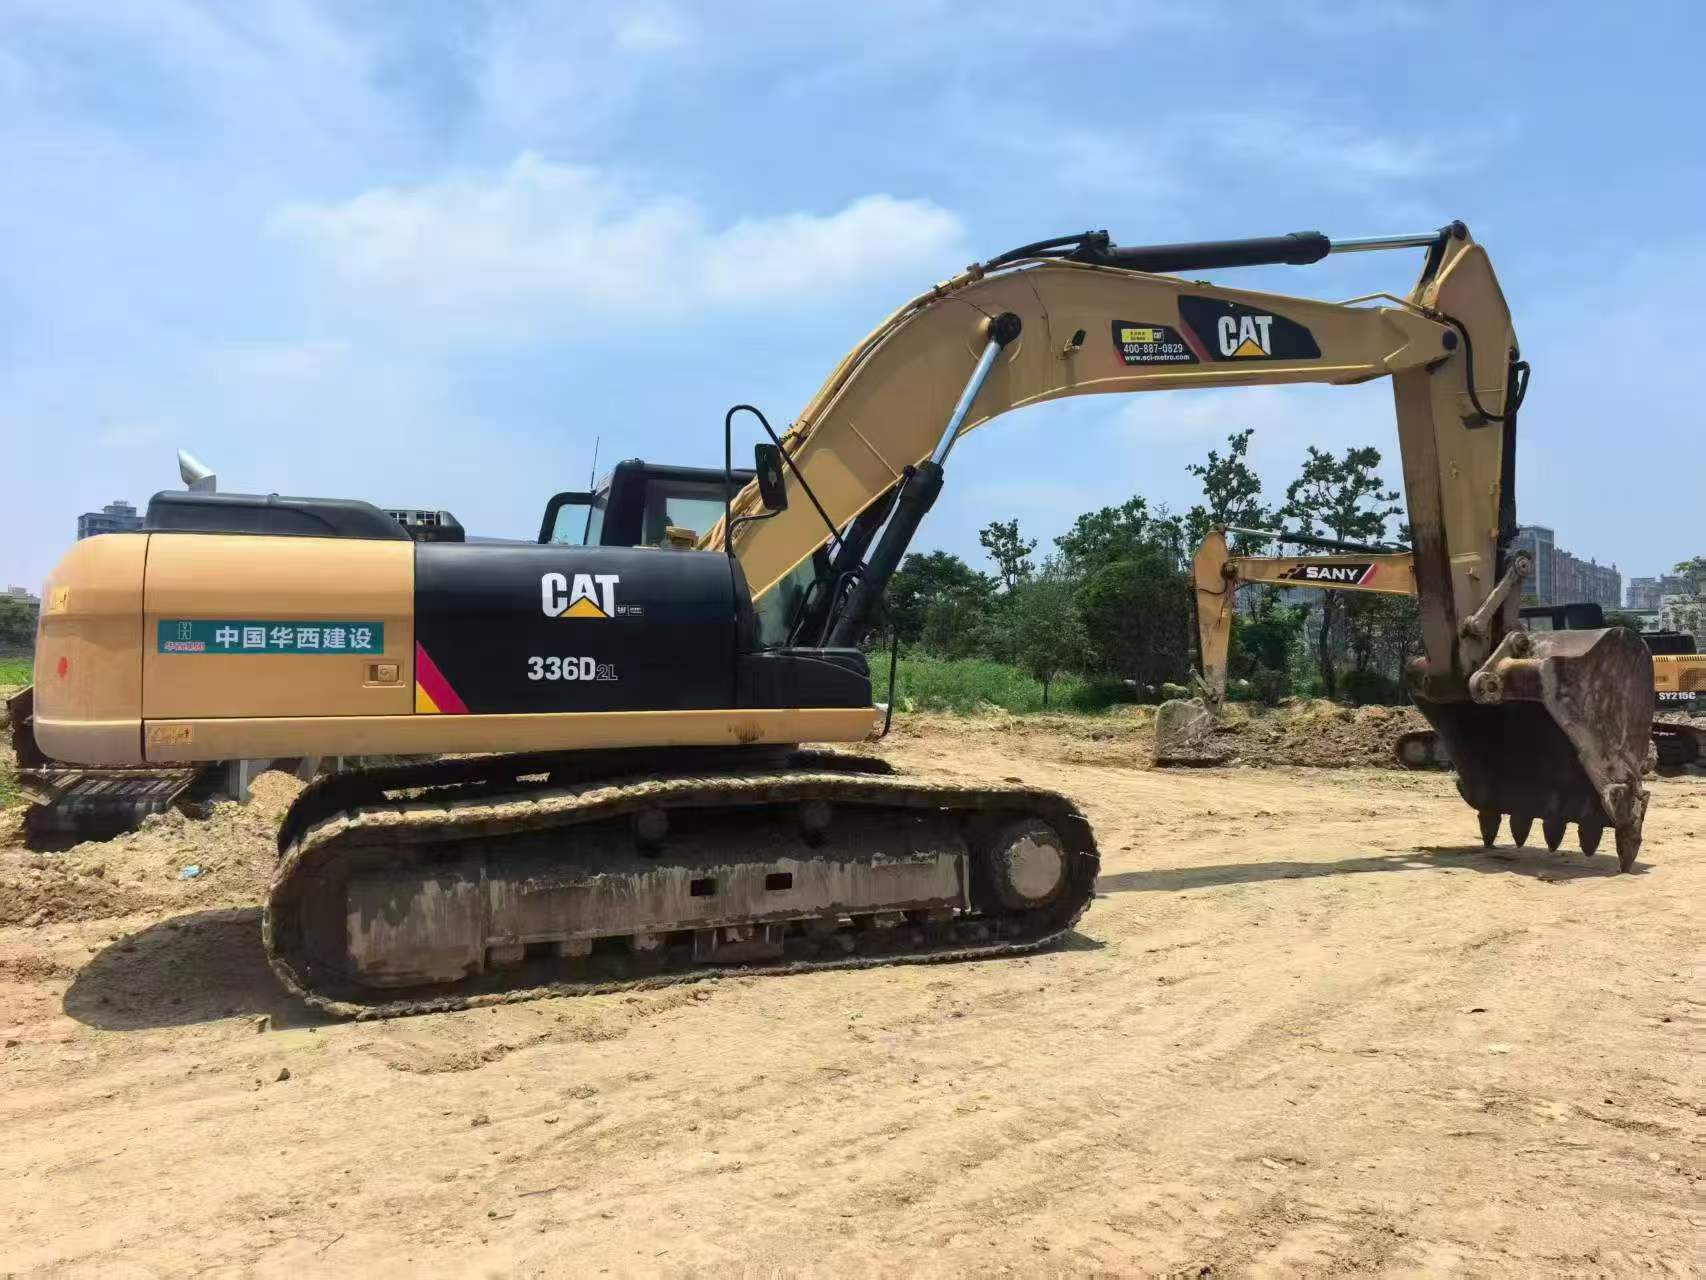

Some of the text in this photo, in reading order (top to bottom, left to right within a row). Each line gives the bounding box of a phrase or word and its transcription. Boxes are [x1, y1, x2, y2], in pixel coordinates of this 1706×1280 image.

[1218, 315, 1273, 357] CAT
[1123, 343, 1184, 354] 400-887-0829
[1306, 566, 1359, 581] SANY
[541, 572, 620, 618] CAT
[215, 625, 372, 649] 中国华西建设
[527, 656, 619, 681] 336D2L
[1658, 691, 1696, 701] SY215C
